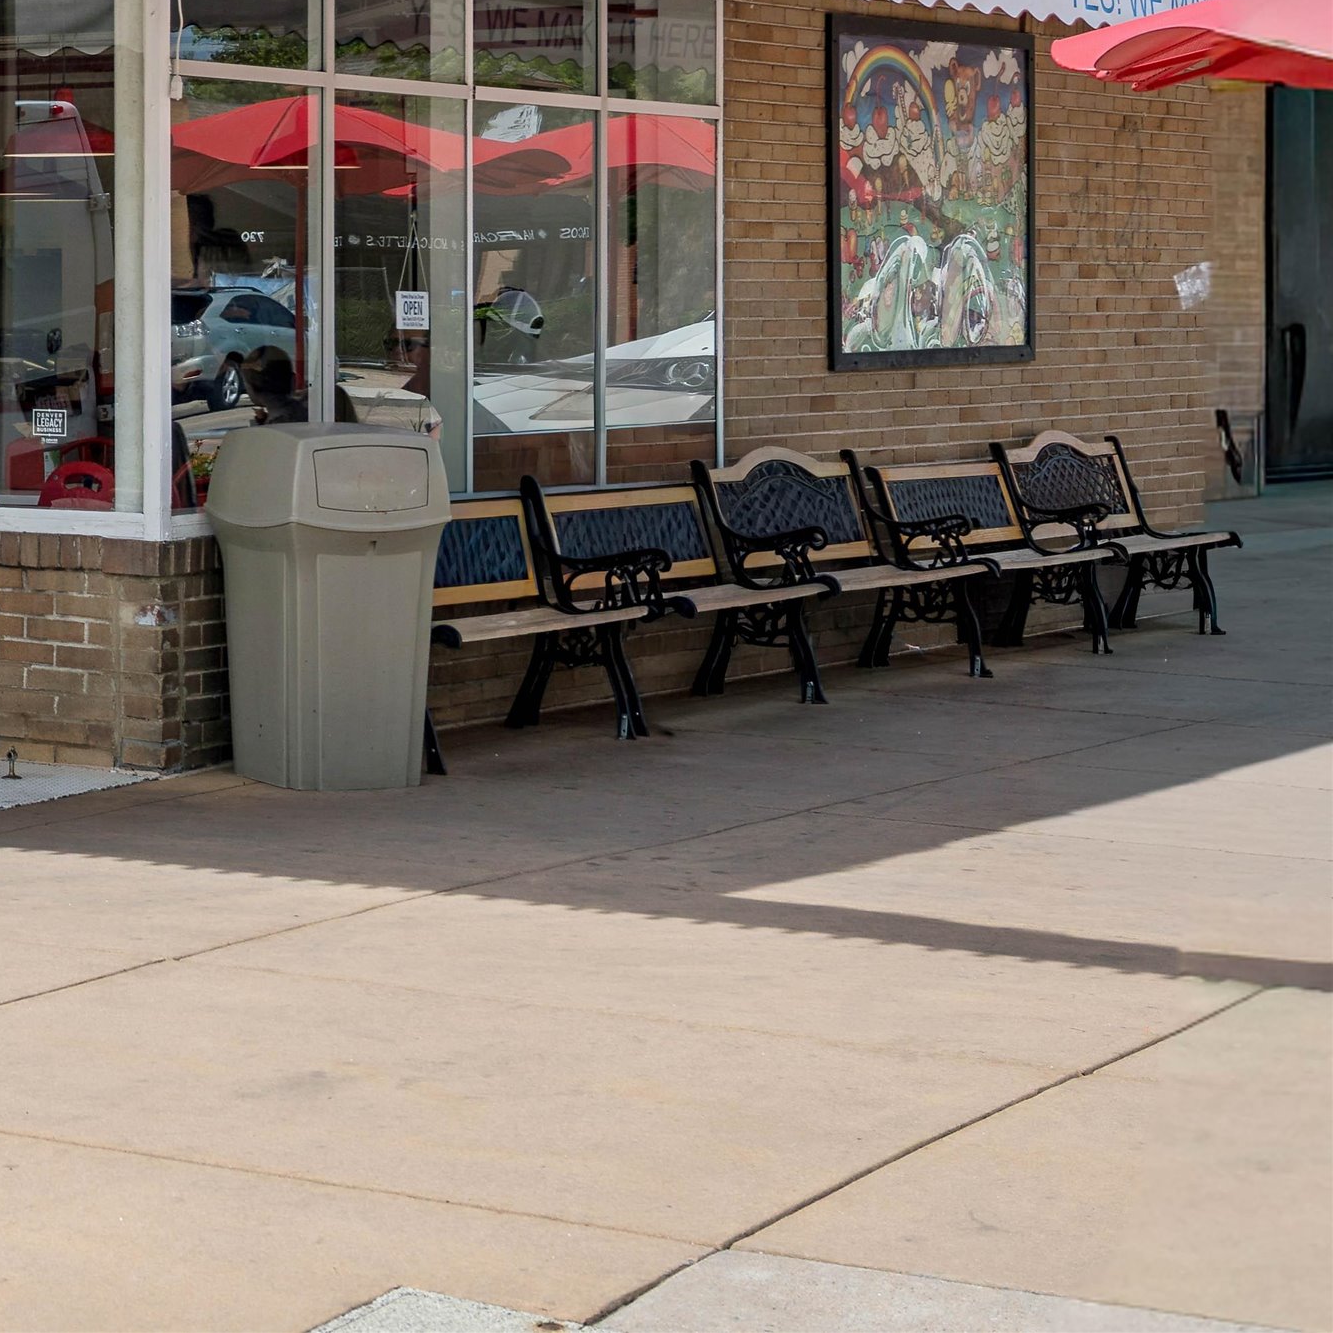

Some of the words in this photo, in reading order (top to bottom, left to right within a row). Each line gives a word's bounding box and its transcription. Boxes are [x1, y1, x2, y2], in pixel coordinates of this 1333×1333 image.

[486, 5, 528, 45] WE
[403, 300, 423, 315] OPEN
[36, 418, 63, 427] LEGACY
